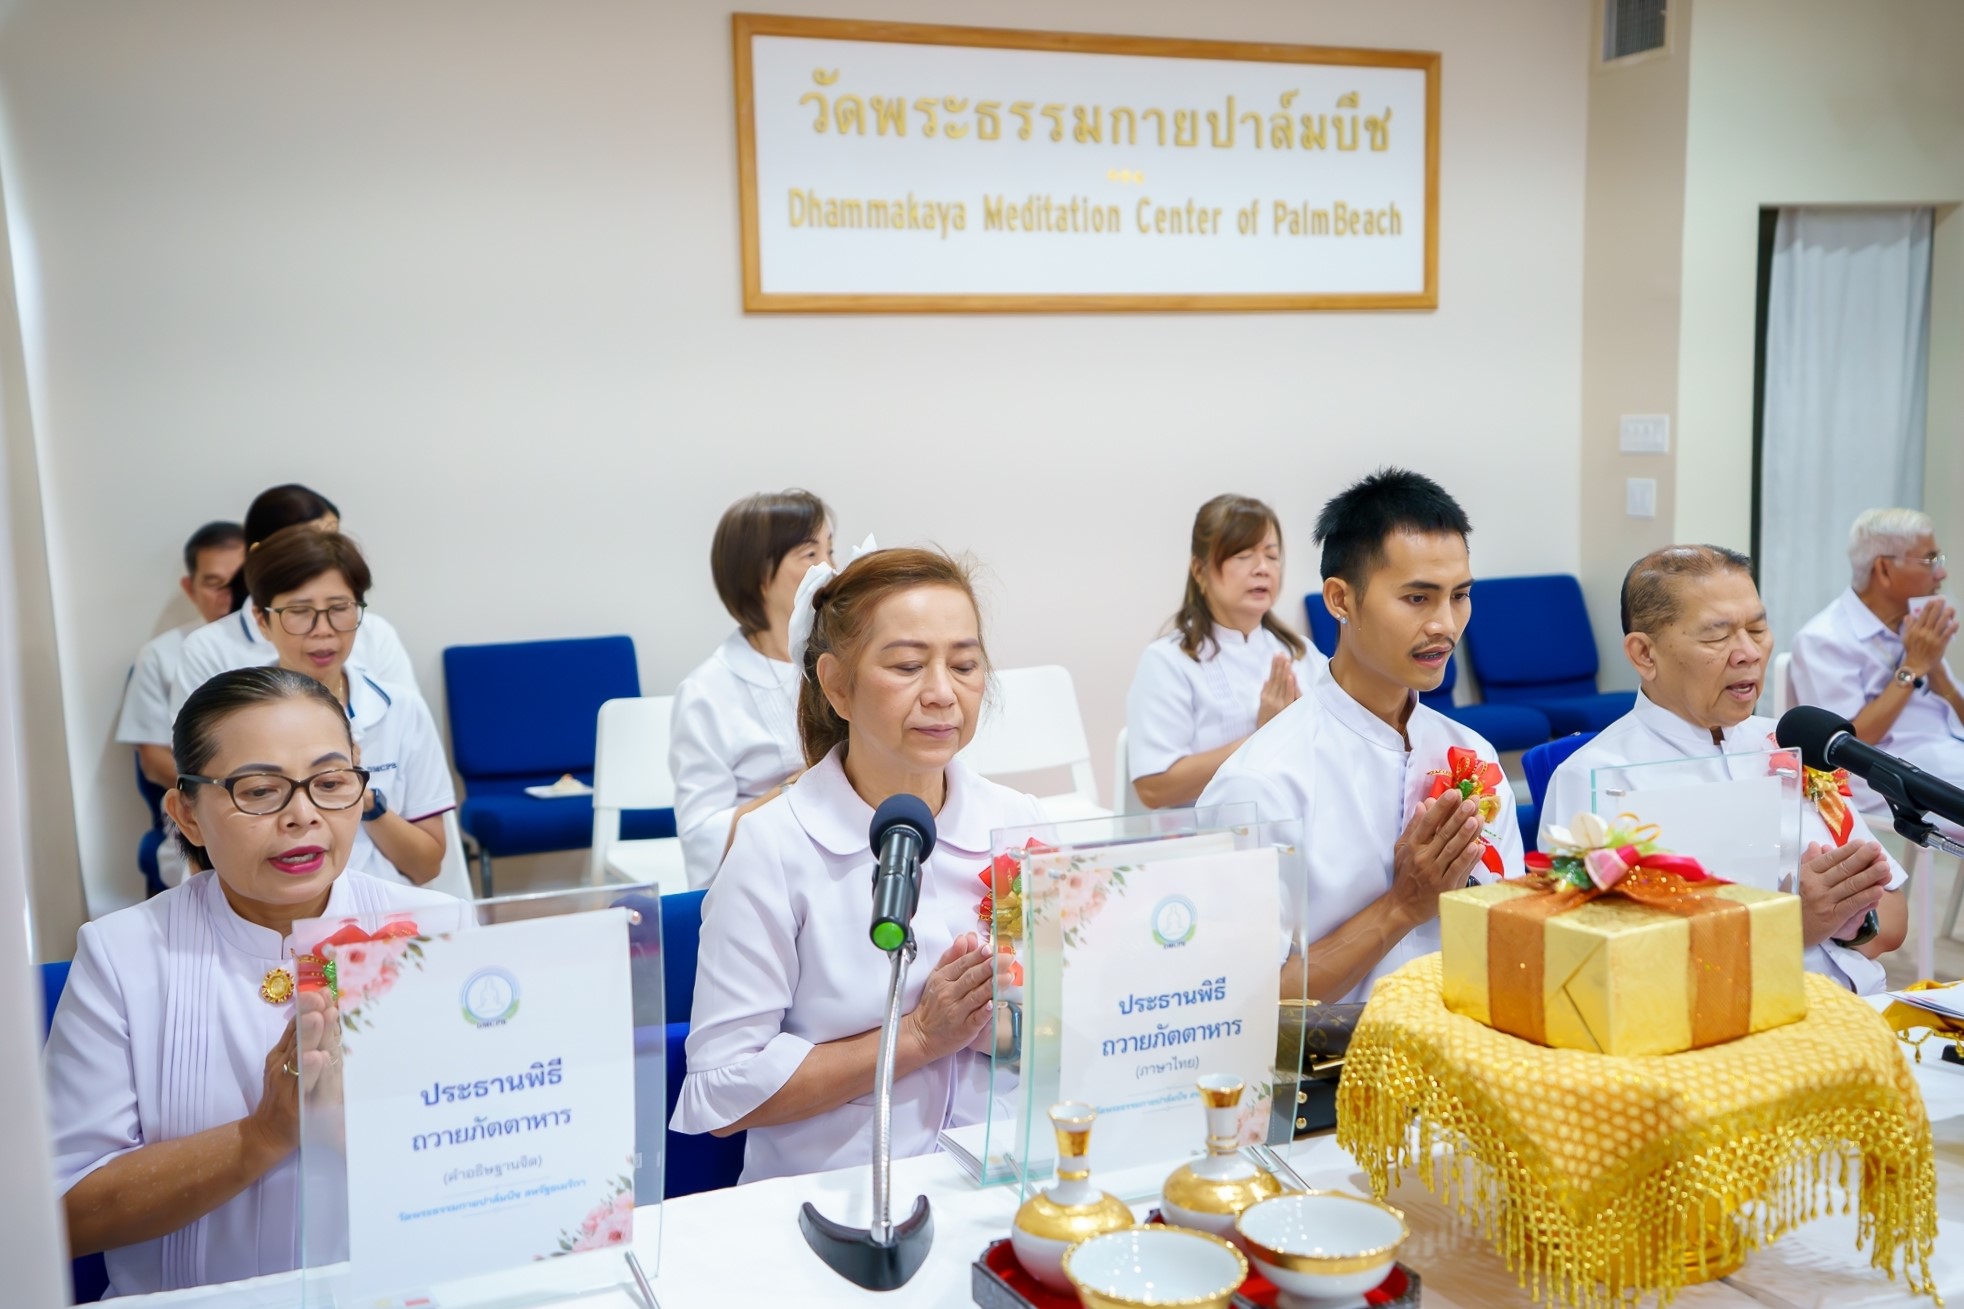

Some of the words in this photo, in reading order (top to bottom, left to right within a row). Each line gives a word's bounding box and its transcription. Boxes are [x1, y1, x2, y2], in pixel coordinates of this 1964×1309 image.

[798, 66, 1394, 152] วัดพระธรรมกายปาล์มบีช
[787, 187, 967, 240] Dhammakaya
[983, 193, 1121, 234] Meditation
[1136, 195, 1223, 236] Center
[1236, 198, 1261, 237] of
[1272, 199, 1404, 238] PalmBeach
[1118, 976, 1226, 1015] ประธานพิธี
[1102, 1019, 1243, 1057] ถวายภัตตาหาร
[420, 1056, 563, 1107] ประธานพิธี
[1135, 1055, 1200, 1080] (ภาษาไทย)
[411, 1107, 572, 1152] ถวายภัตตาหาร
